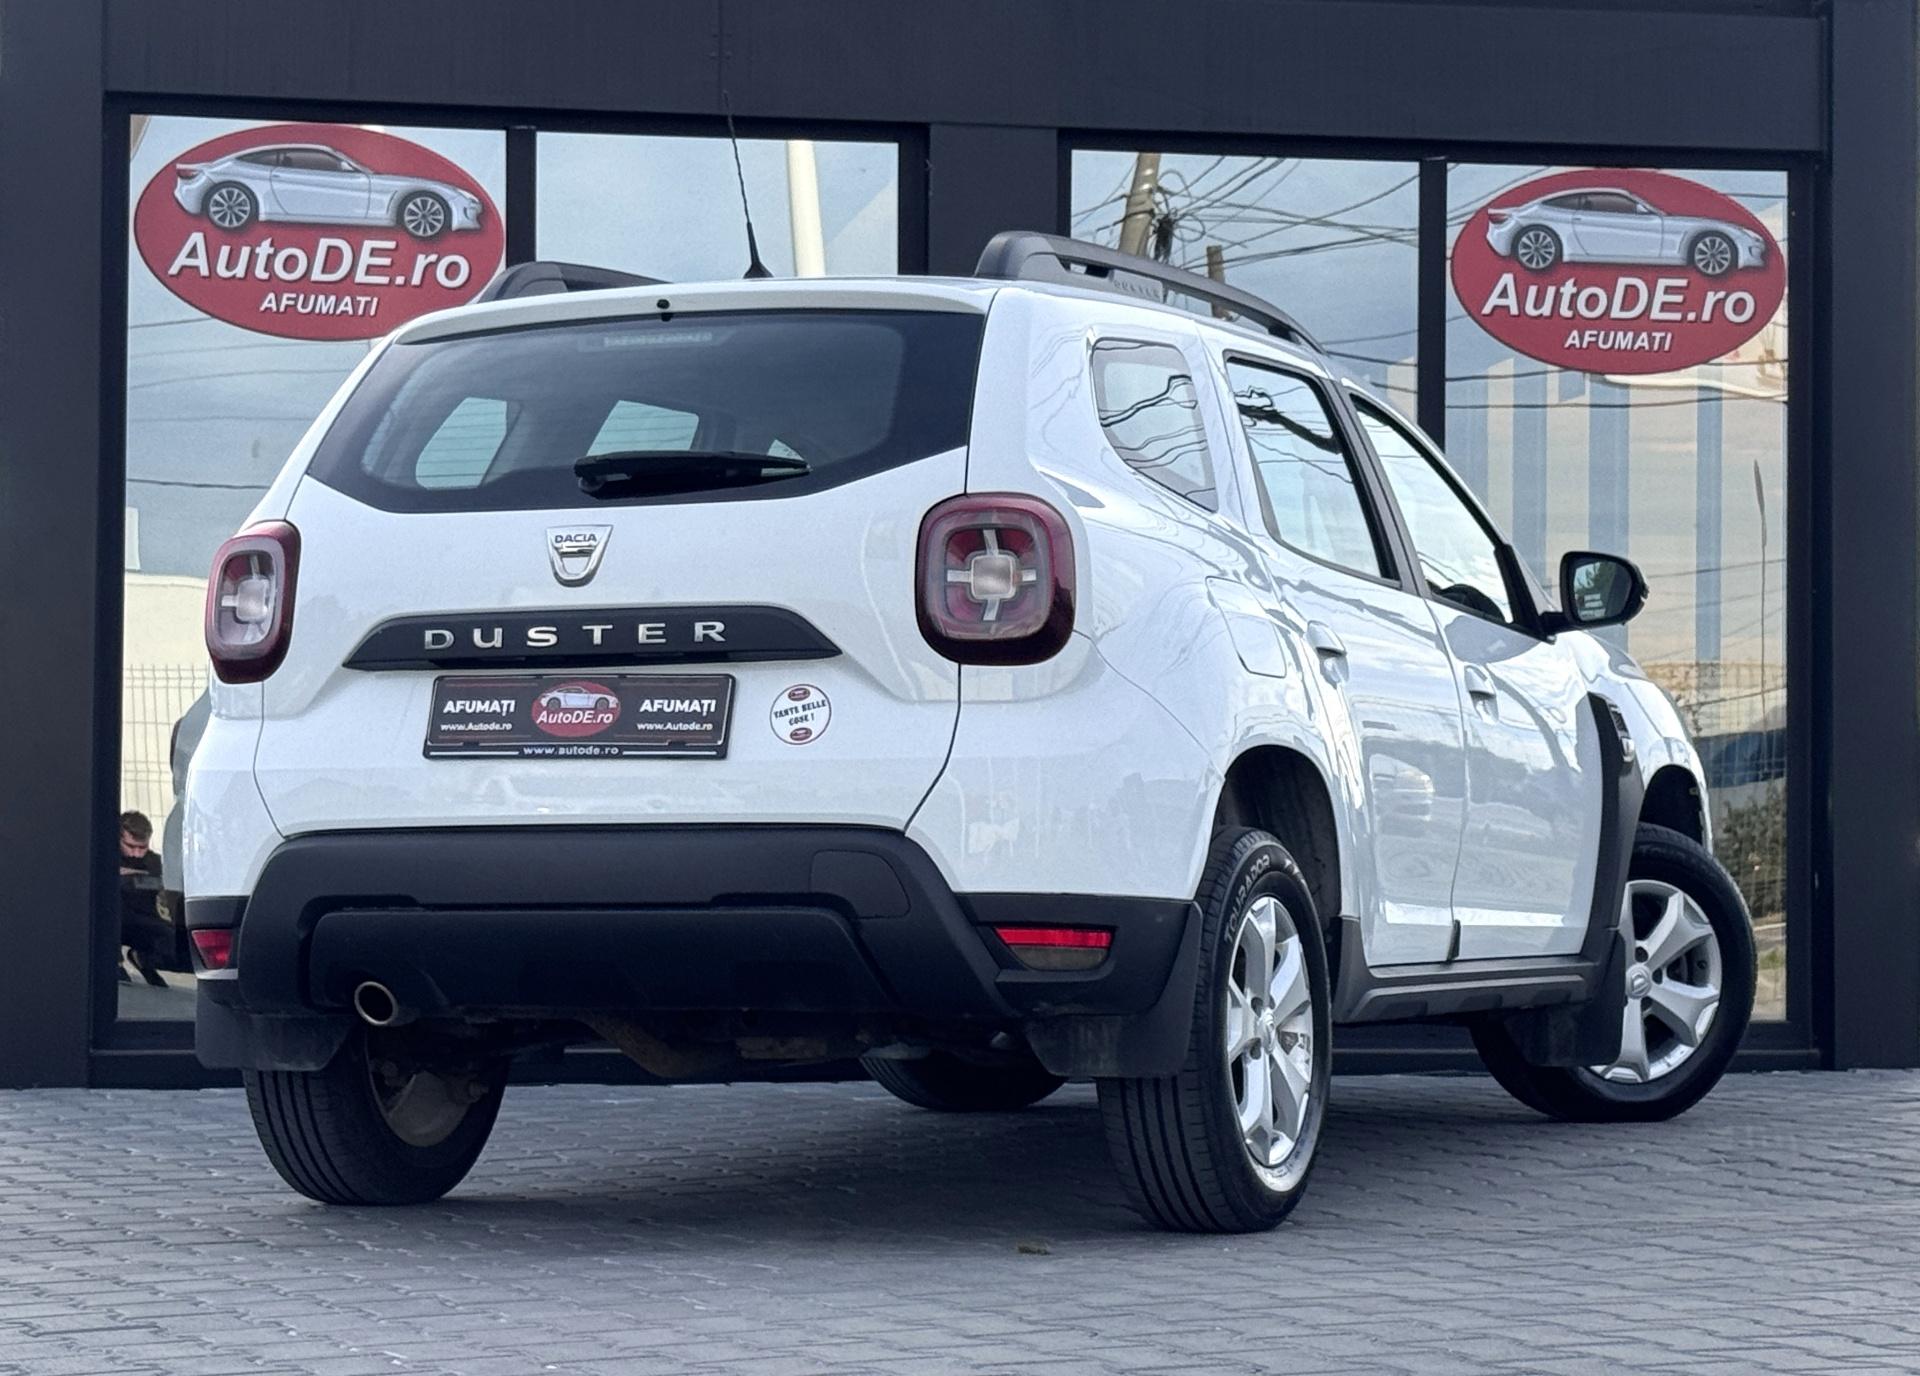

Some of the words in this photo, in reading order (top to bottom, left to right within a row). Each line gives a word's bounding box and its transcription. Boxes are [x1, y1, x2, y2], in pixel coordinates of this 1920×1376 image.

[168, 231, 471, 288] AutoDE.ro
[260, 293, 379, 317] AFUMATI
[1481, 273, 1756, 323] AutoDE.ro
[1564, 330, 1673, 352] AFUMATI
[555, 533, 597, 543] DACIA
[423, 621, 727, 650] DUSTER
[536, 710, 613, 724] AutoDE.ro
[523, 746, 619, 755] www.autode.ro
